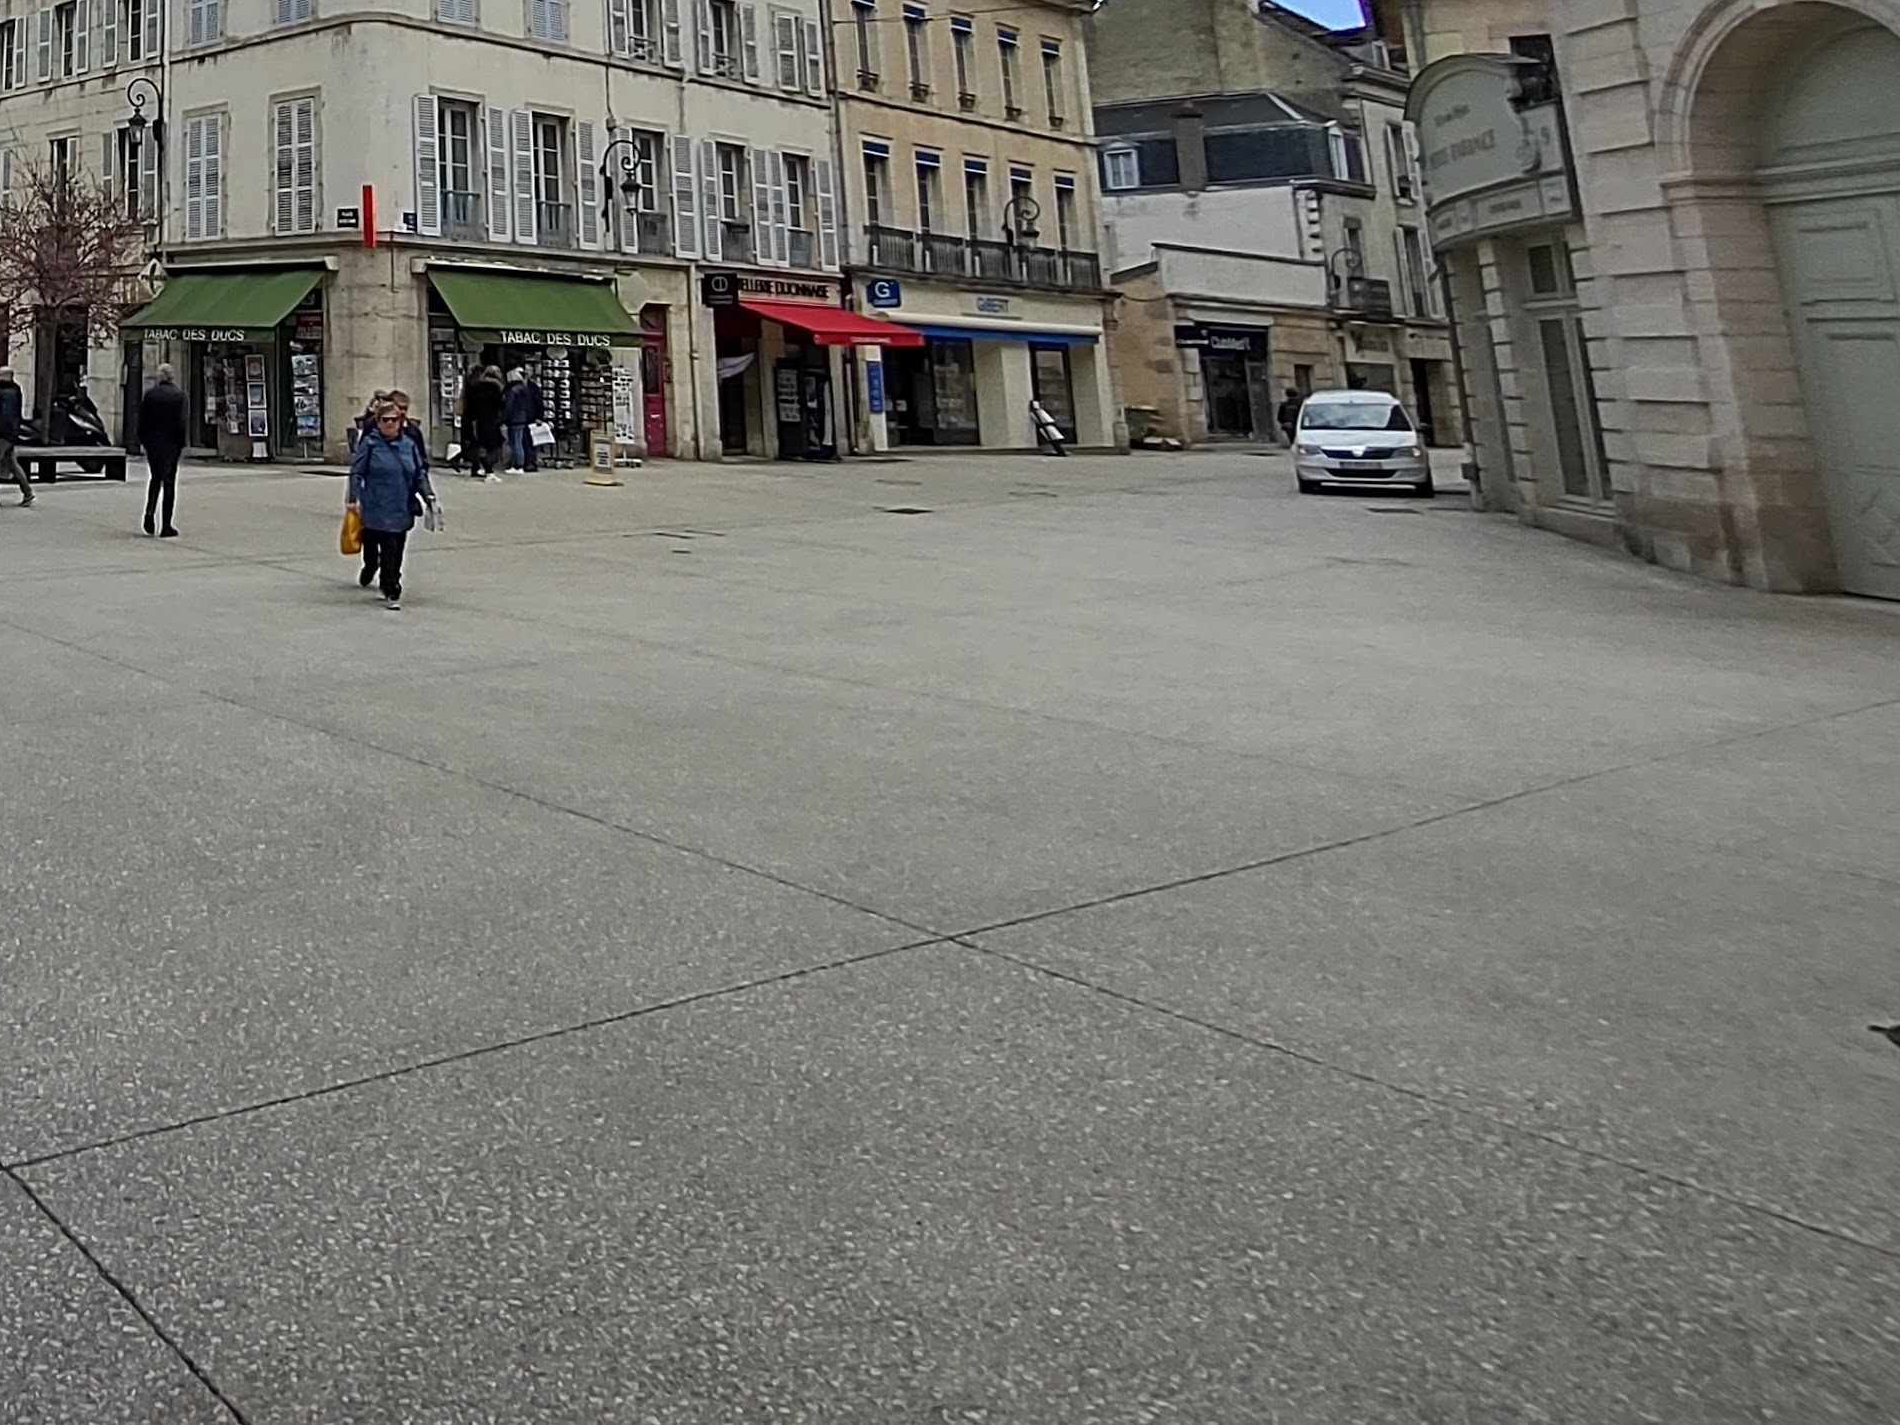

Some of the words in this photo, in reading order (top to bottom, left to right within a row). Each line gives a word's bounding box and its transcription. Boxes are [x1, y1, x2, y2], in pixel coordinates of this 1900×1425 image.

[143, 329, 178, 340] TABAC
[182, 329, 206, 341] DES
[211, 329, 245, 341] DUCS
[499, 331, 541, 344] TABAC
[546, 333, 572, 345] DES
[577, 334, 611, 347] DUCS
